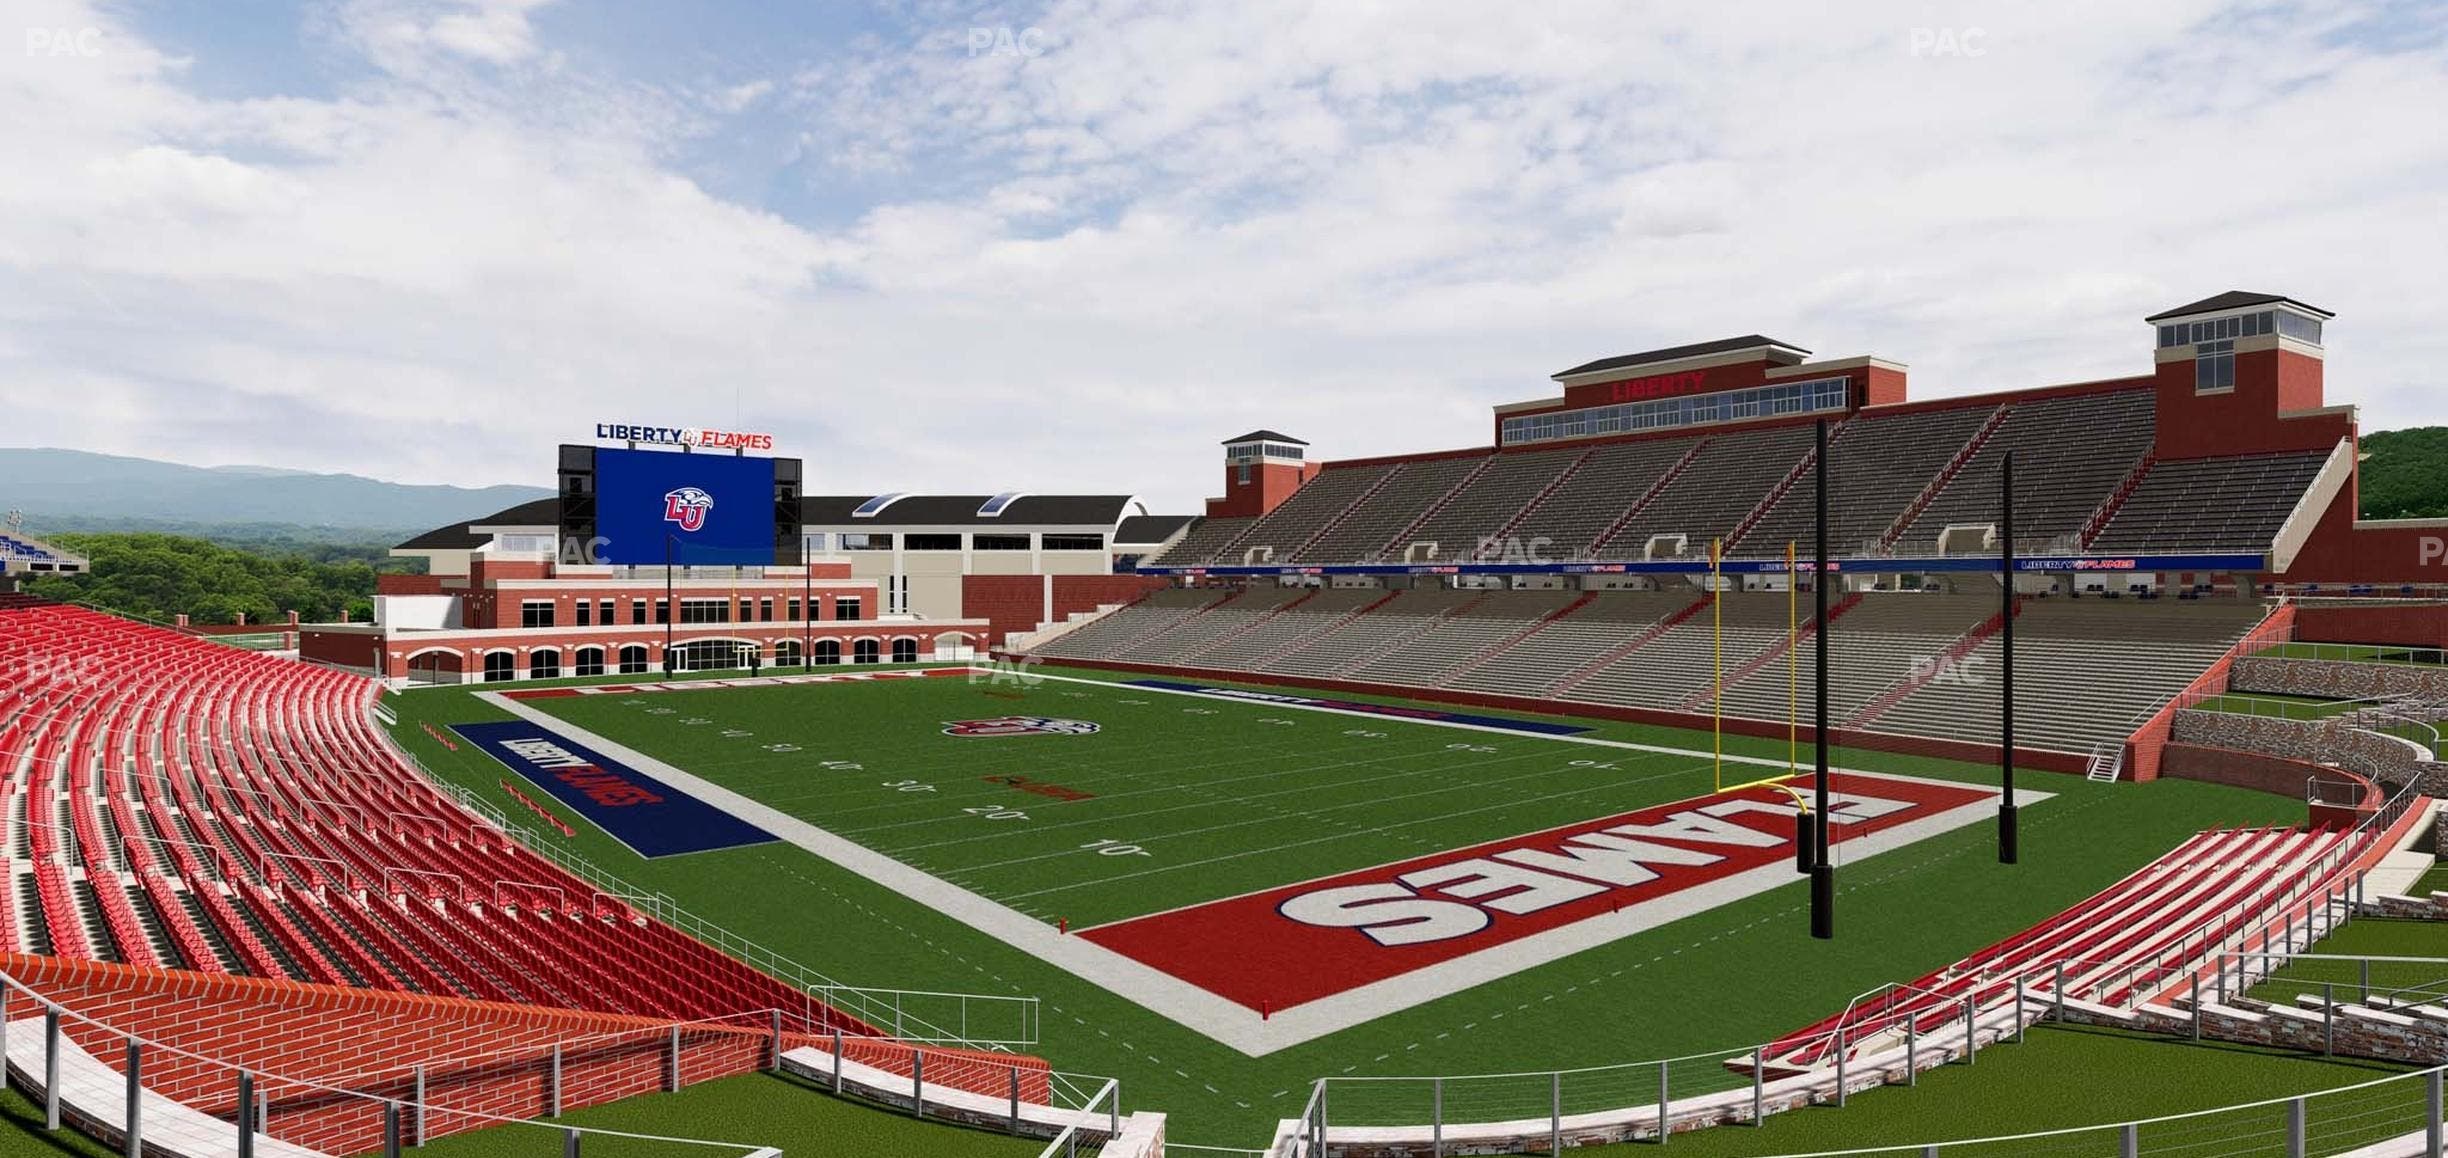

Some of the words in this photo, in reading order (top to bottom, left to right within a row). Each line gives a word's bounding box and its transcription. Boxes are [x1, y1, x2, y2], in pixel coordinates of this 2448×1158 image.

[1613, 371, 1705, 401] LIBERTY
[597, 424, 682, 443] LIBERTY
[701, 431, 772, 449] FLAMES
[665, 495, 704, 531] LU
[2021, 561, 2073, 569] LIBERTY
[2083, 560, 2136, 569] FLAMES
[499, 738, 596, 769] LIBERTY
[962, 804, 1027, 820] 20
[1080, 838, 1146, 856] 10
[1275, 784, 1919, 949] FLAMES
